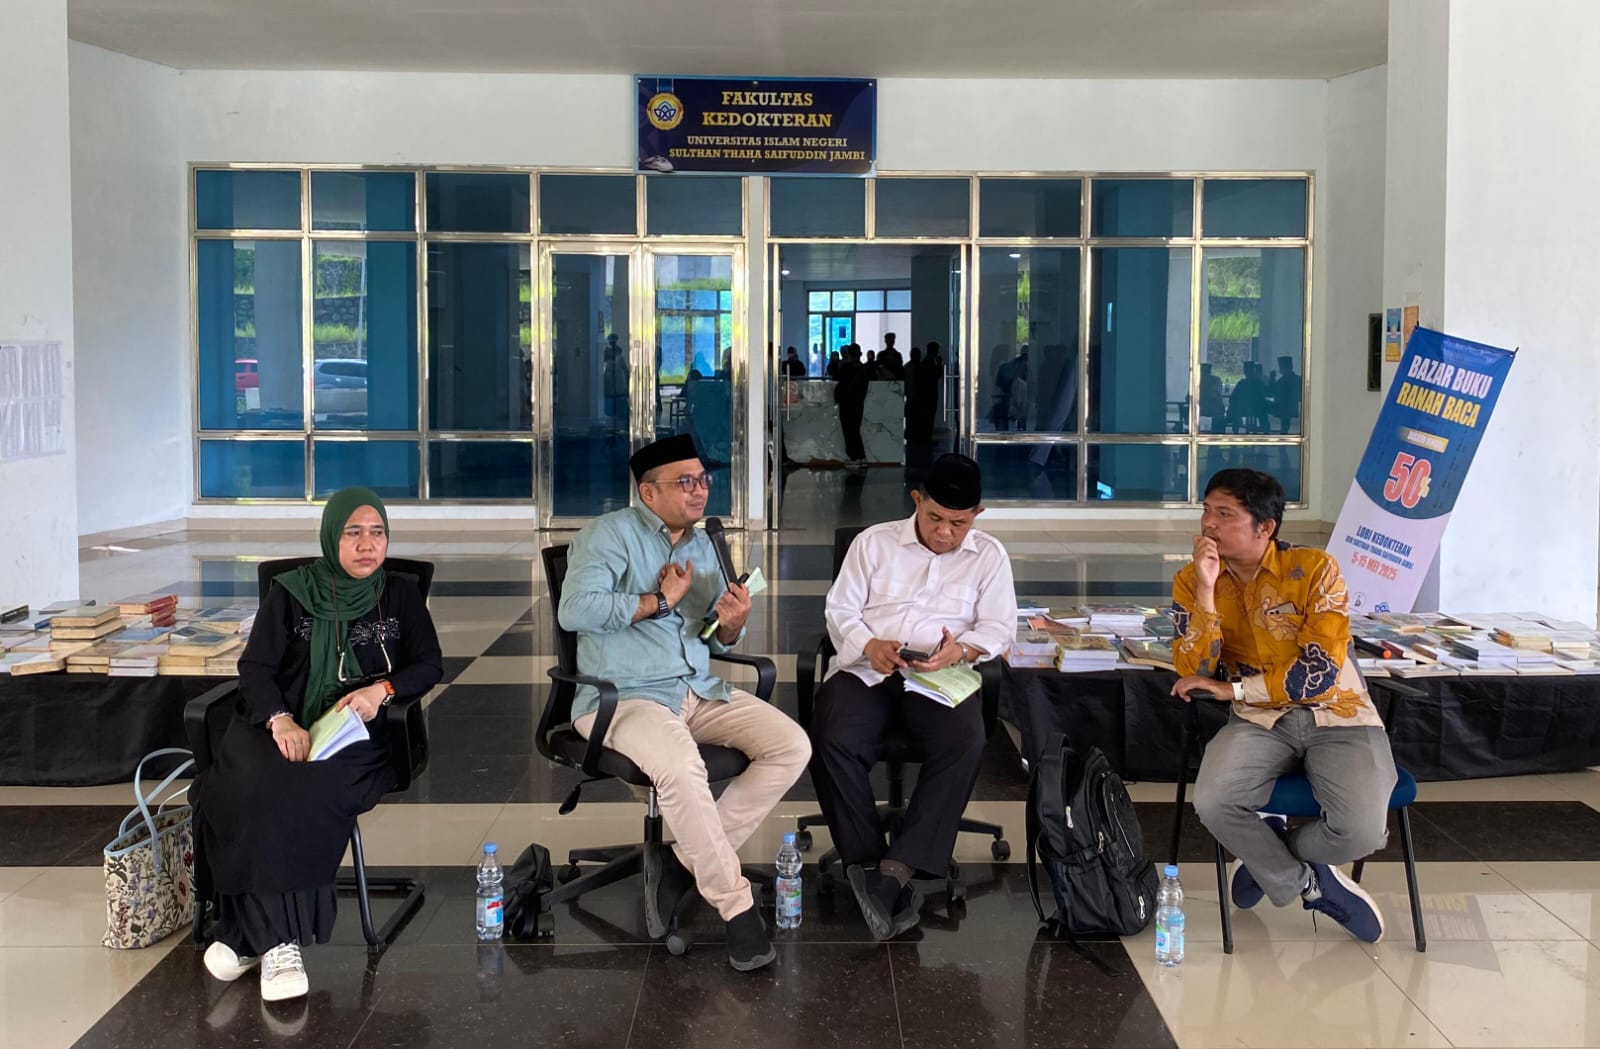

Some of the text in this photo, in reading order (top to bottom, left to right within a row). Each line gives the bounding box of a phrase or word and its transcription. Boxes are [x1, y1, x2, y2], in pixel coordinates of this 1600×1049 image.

[721, 91, 813, 107] FAKULTAS
[702, 112, 833, 128] KEDOKTERAN
[687, 135, 848, 148] UNIVERSITAS ISLAM NEGERI
[669, 148, 866, 161] SULTHAN THAHA SAIFUDDIN JAMBI
[1407, 355, 1494, 399] BAZAR BUKU
[1396, 382, 1481, 428] RANAH BACA
[1356, 525, 1413, 558] LOBI KEDOKTERAN
